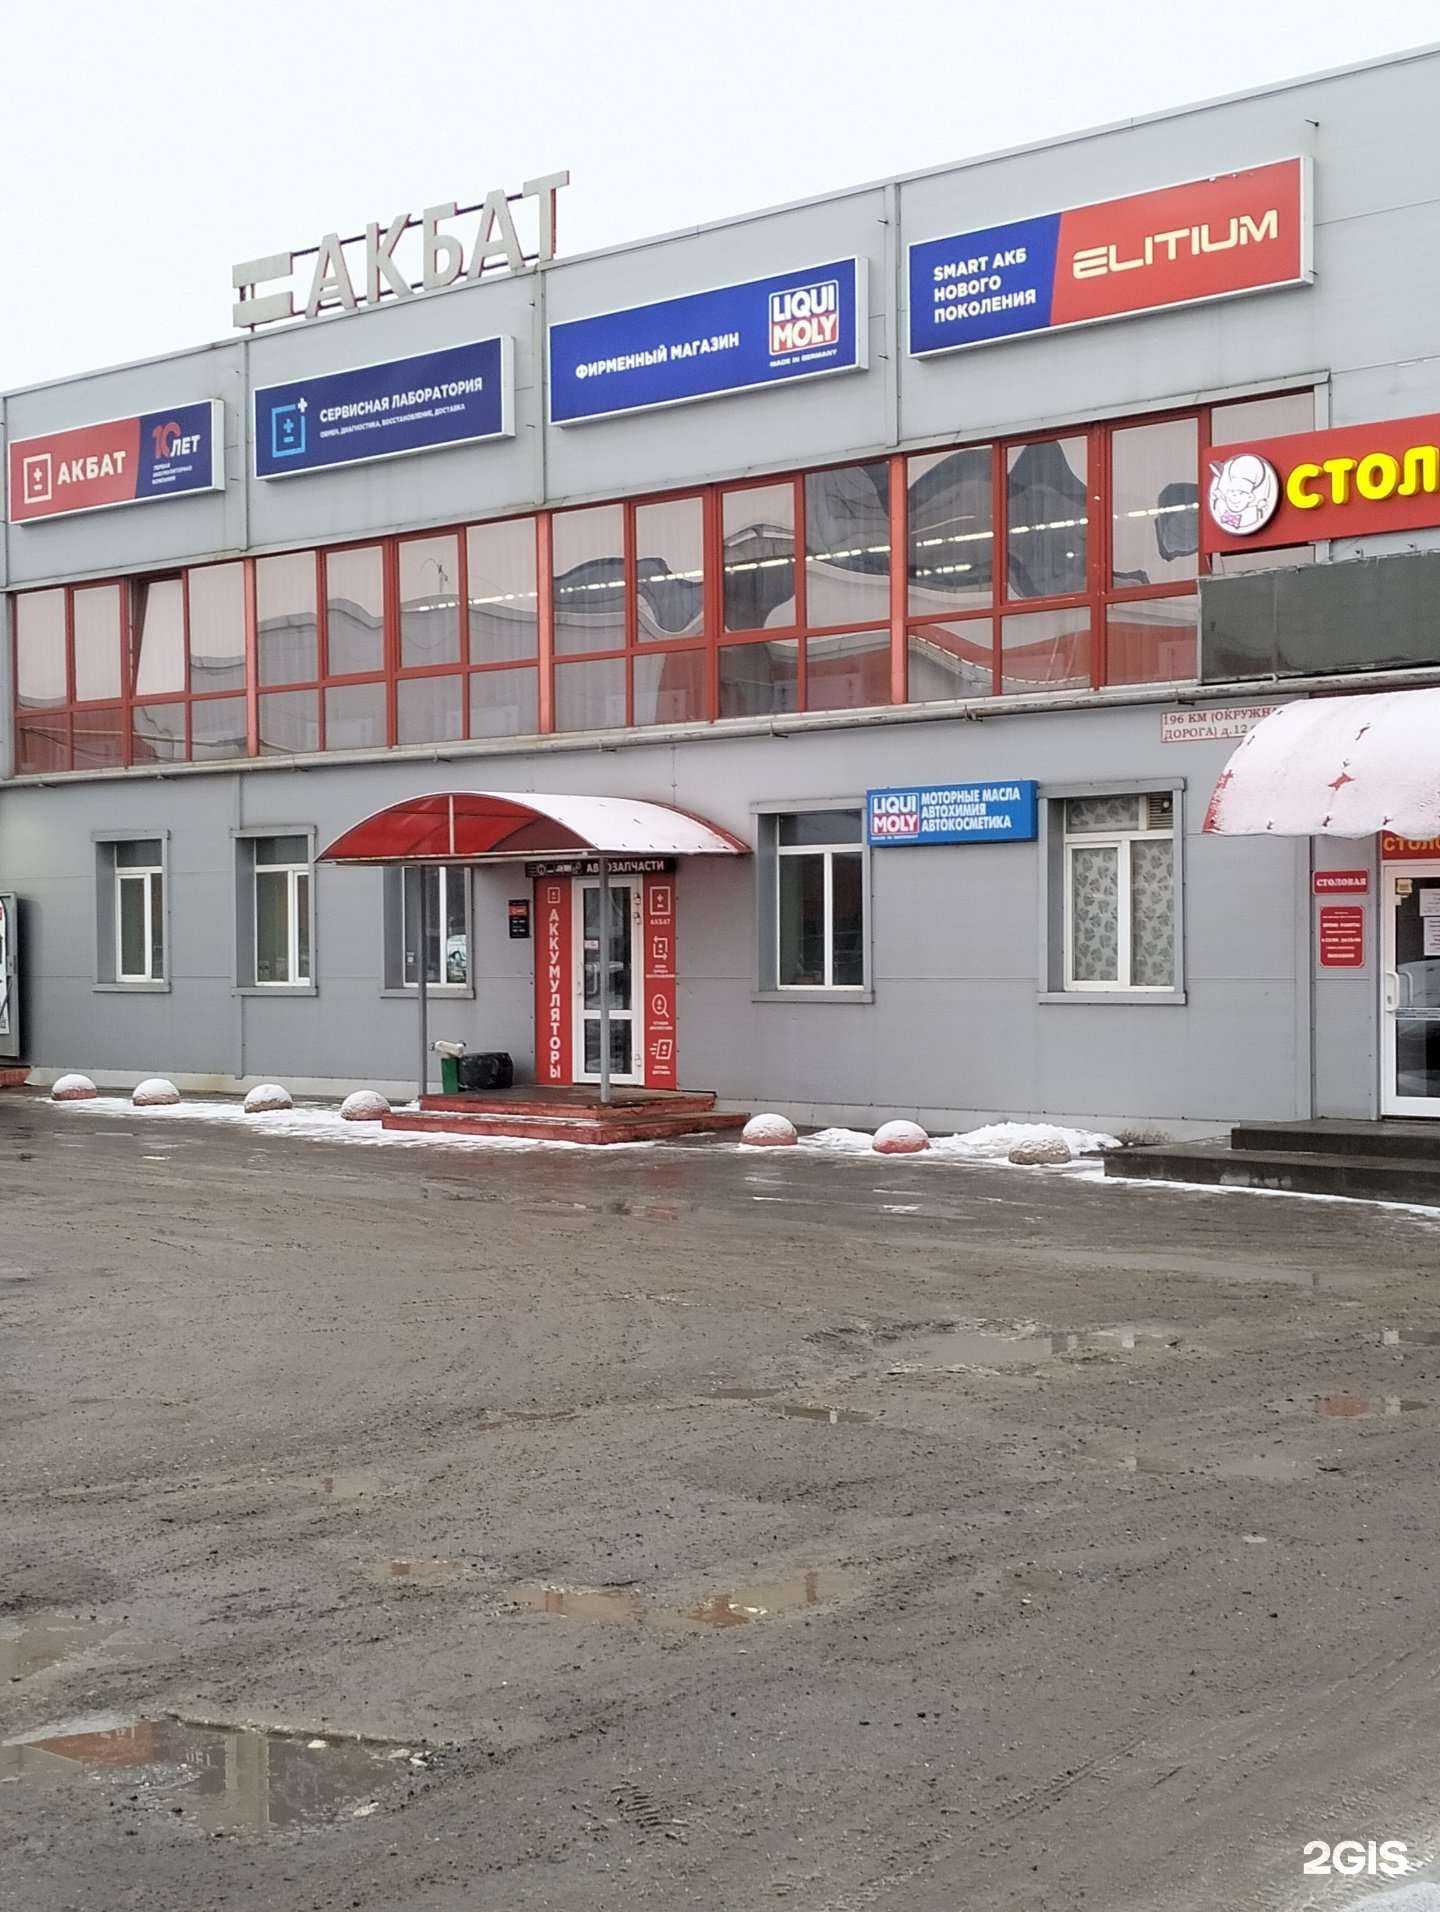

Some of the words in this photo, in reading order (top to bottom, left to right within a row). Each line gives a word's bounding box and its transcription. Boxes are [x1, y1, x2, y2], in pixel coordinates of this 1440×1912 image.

[305, 169, 570, 319] АКБАТ
[1072, 208, 1279, 280] ELITIUM
[933, 254, 988, 282] SMART
[993, 247, 1027, 268] АКБ
[772, 284, 836, 323] LIQUI
[934, 275, 1002, 303] НОВОГО
[934, 289, 1037, 324] ПОКОЛЕНИЯ
[772, 315, 837, 352] MOLY
[575, 345, 668, 380] ФИРМЕННЫЙ
[670, 332, 740, 361] МАГАЗИН
[320, 396, 391, 423] СЕРВИСНАЯ
[391, 377, 483, 409] ЛАБОРАТОРИЯ
[170, 434, 201, 458] ЛЕТ
[57, 450, 126, 485] АКБАТ
[1286, 444, 1440, 509] СТОЛ
[1188, 713, 1207, 724] КМ
[1211, 707, 1276, 722] (ОКРУЖН
[873, 794, 917, 814] LIQUI
[921, 790, 980, 806] МОТОРНЫЕ
[982, 787, 1021, 801] МАСЛА
[921, 804, 987, 819] АВТОХИМИЯ
[873, 814, 918, 833] MOLY
[921, 815, 1012, 832] АВТОКОСМЕТИКА
[586, 860, 664, 873] АВОЗАПЧАСТИ
[1316, 877, 1367, 888] СТОЛОВАЯ
[548, 908, 561, 1078] АККУМУЛЯТОРЫ
